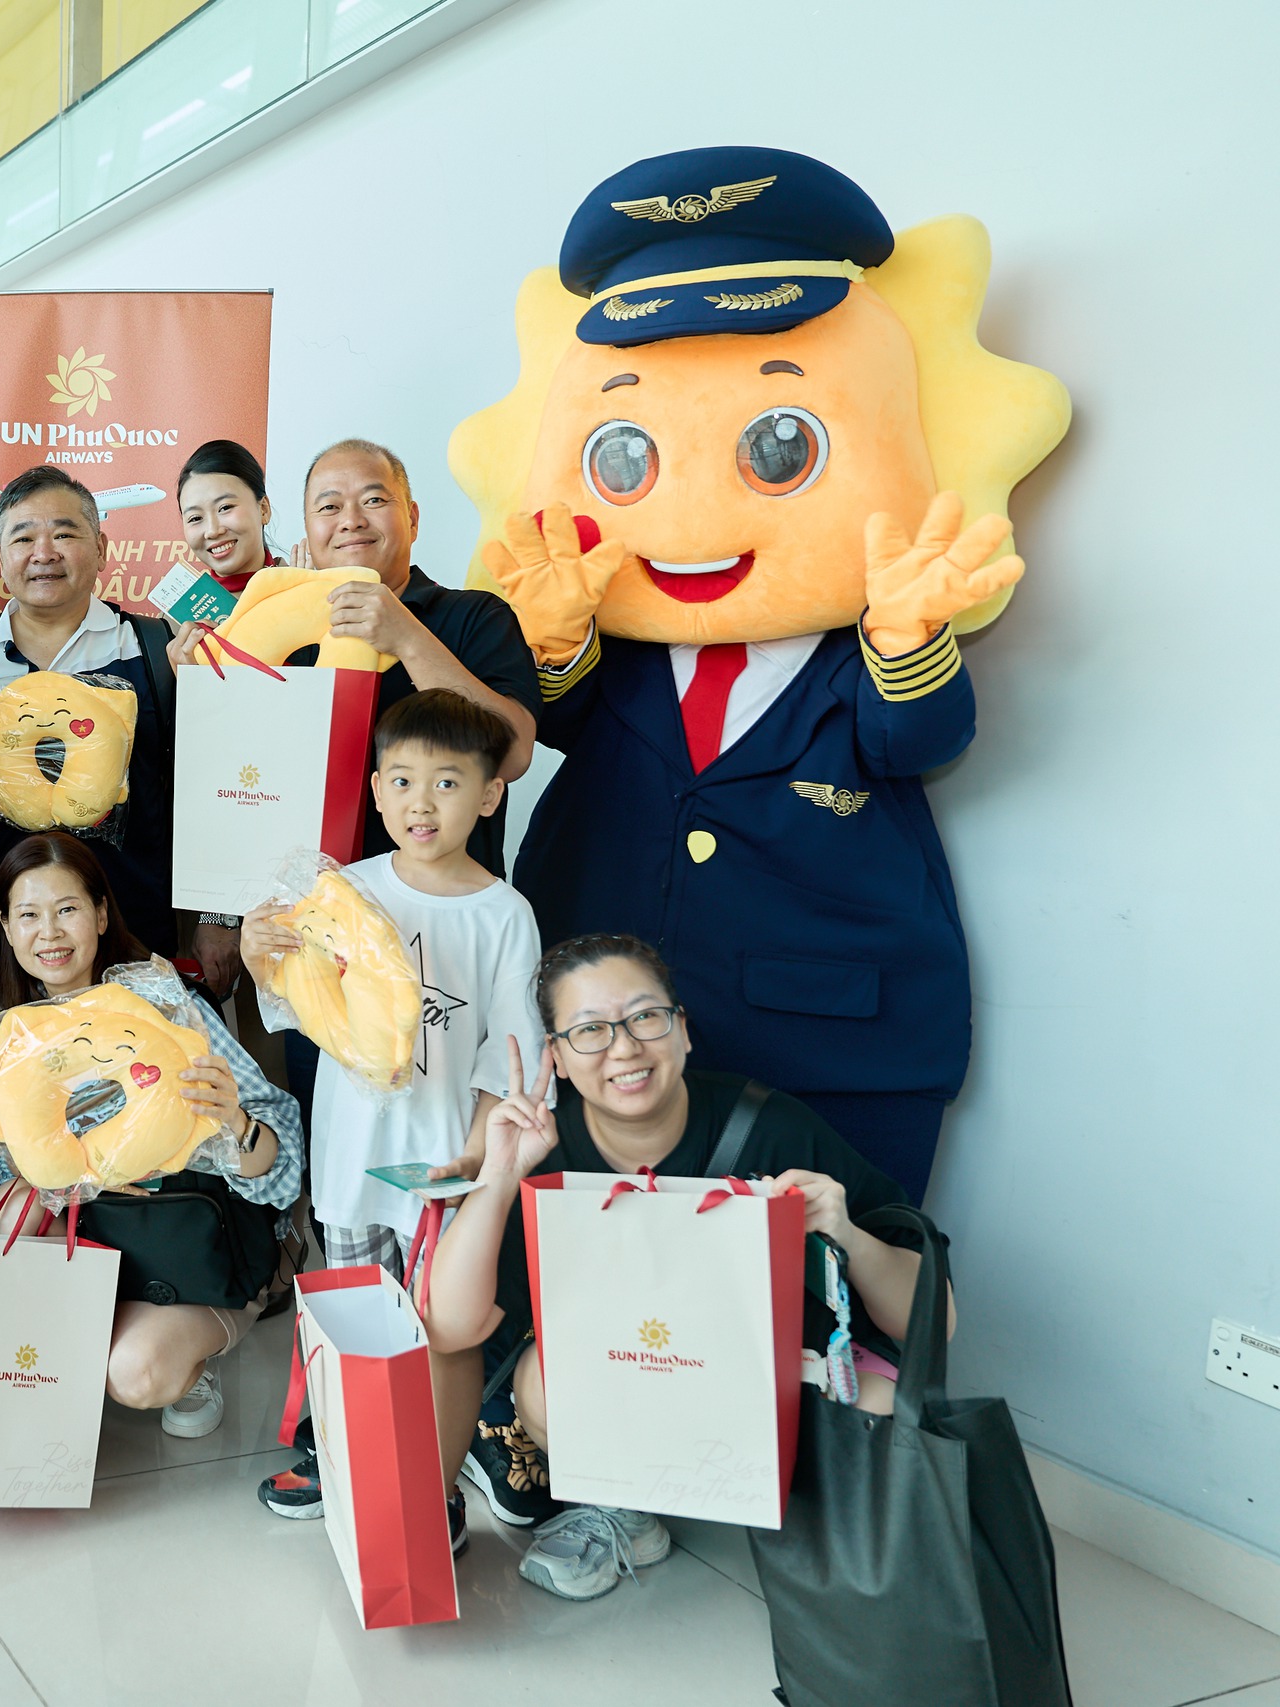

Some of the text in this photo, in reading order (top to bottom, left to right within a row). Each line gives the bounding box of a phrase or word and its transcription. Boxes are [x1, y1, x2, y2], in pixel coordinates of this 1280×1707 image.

[47, 423, 179, 448] PhuQuoc
[45, 451, 114, 464] AIRWAYS
[106, 540, 145, 562] NH
[192, 595, 217, 620] TAIWAN
[217, 789, 281, 801] SUN PhuQuoc
[608, 1350, 704, 1368] SUN PhuQuoc
[639, 1365, 673, 1373] AIRWAYS
[13, 1372, 59, 1384] PhuQuoc
[41, 1441, 95, 1473] Rise
[2, 1466, 89, 1508] Together
